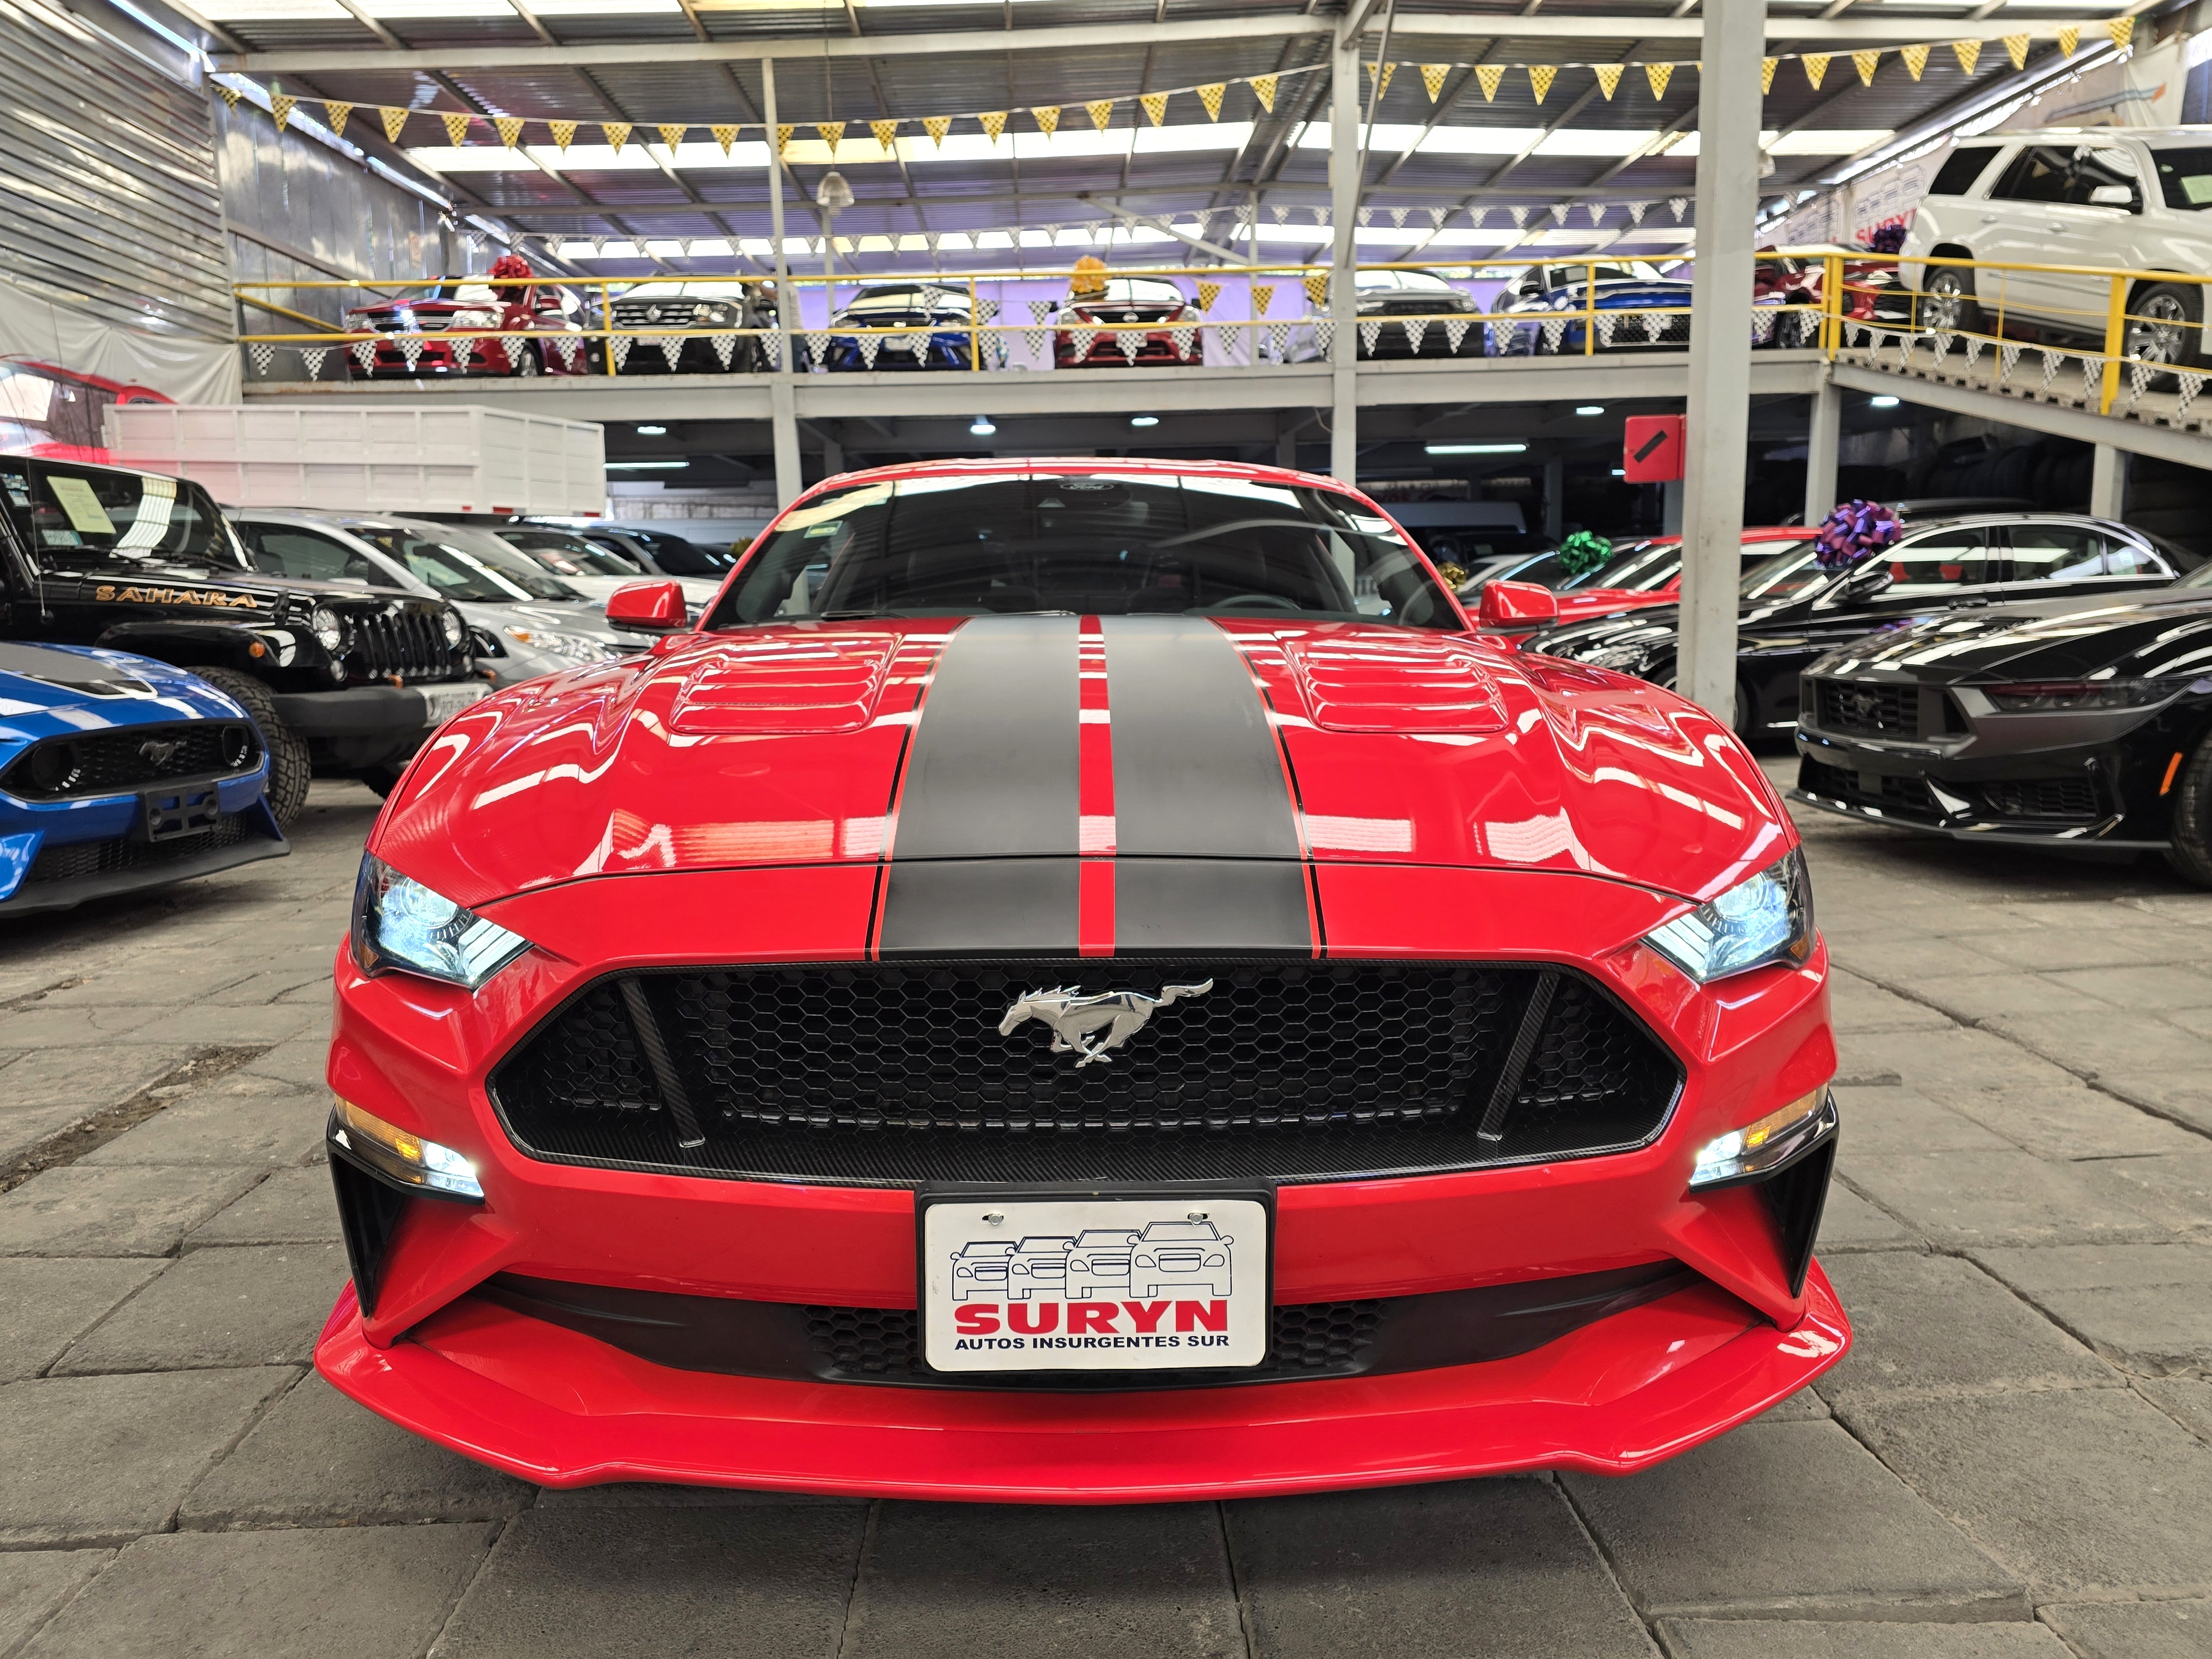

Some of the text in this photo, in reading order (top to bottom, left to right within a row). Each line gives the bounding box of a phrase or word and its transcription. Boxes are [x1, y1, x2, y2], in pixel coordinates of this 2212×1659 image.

[96, 585, 258, 608] SAHARA
[954, 1300, 1228, 1335] SURYN
[954, 1335, 1230, 1350] AUTOS INSURGENTES SUR
